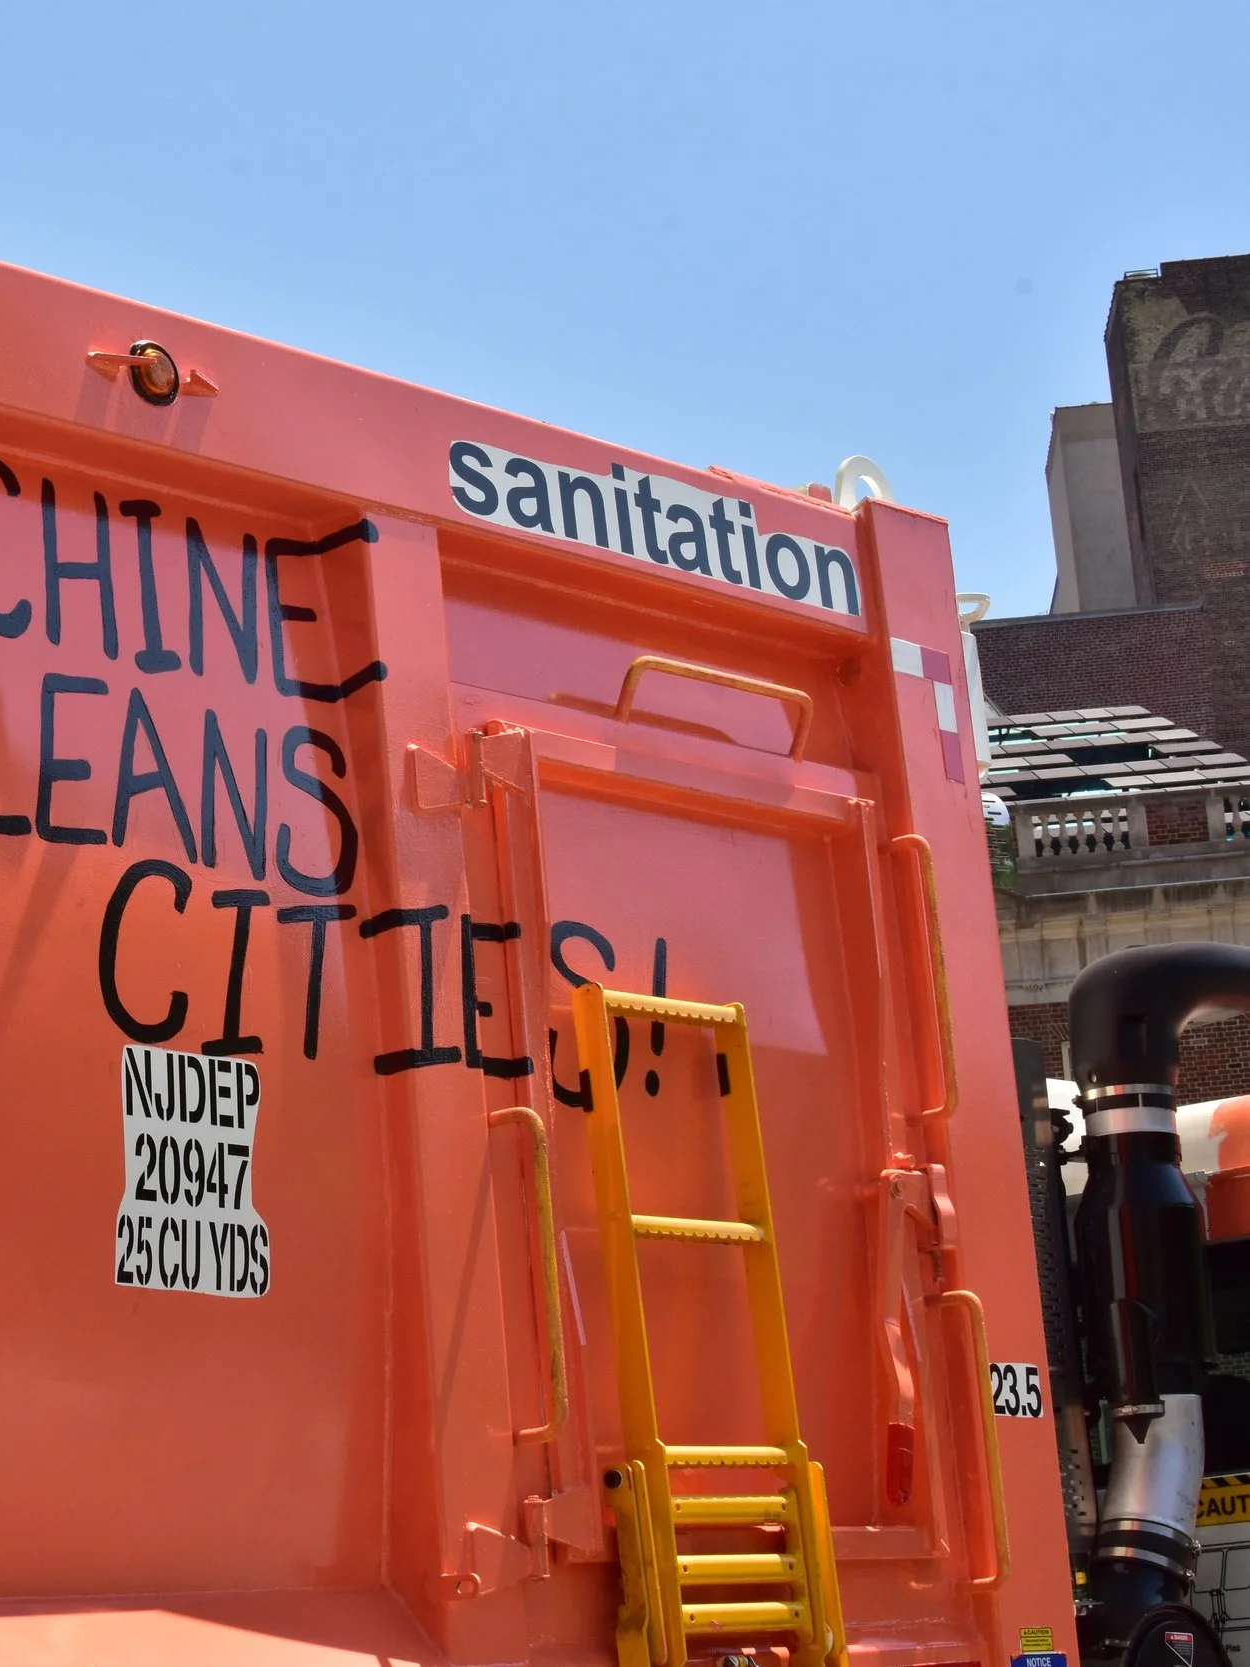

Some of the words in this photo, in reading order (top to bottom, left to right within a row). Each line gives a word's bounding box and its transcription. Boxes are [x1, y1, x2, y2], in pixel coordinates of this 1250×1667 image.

[450, 441, 860, 616] sanitation
[99, 858, 668, 1113] CITIES!
[125, 1047, 260, 1129] NJDEP
[135, 1132, 250, 1210] 20947
[117, 1213, 153, 1286] 25
[158, 1215, 202, 1290] CU
[209, 1221, 269, 1296] YDS
[989, 1363, 1042, 1418] 23.5
[1026, 1657, 1052, 1667] NOTICE
